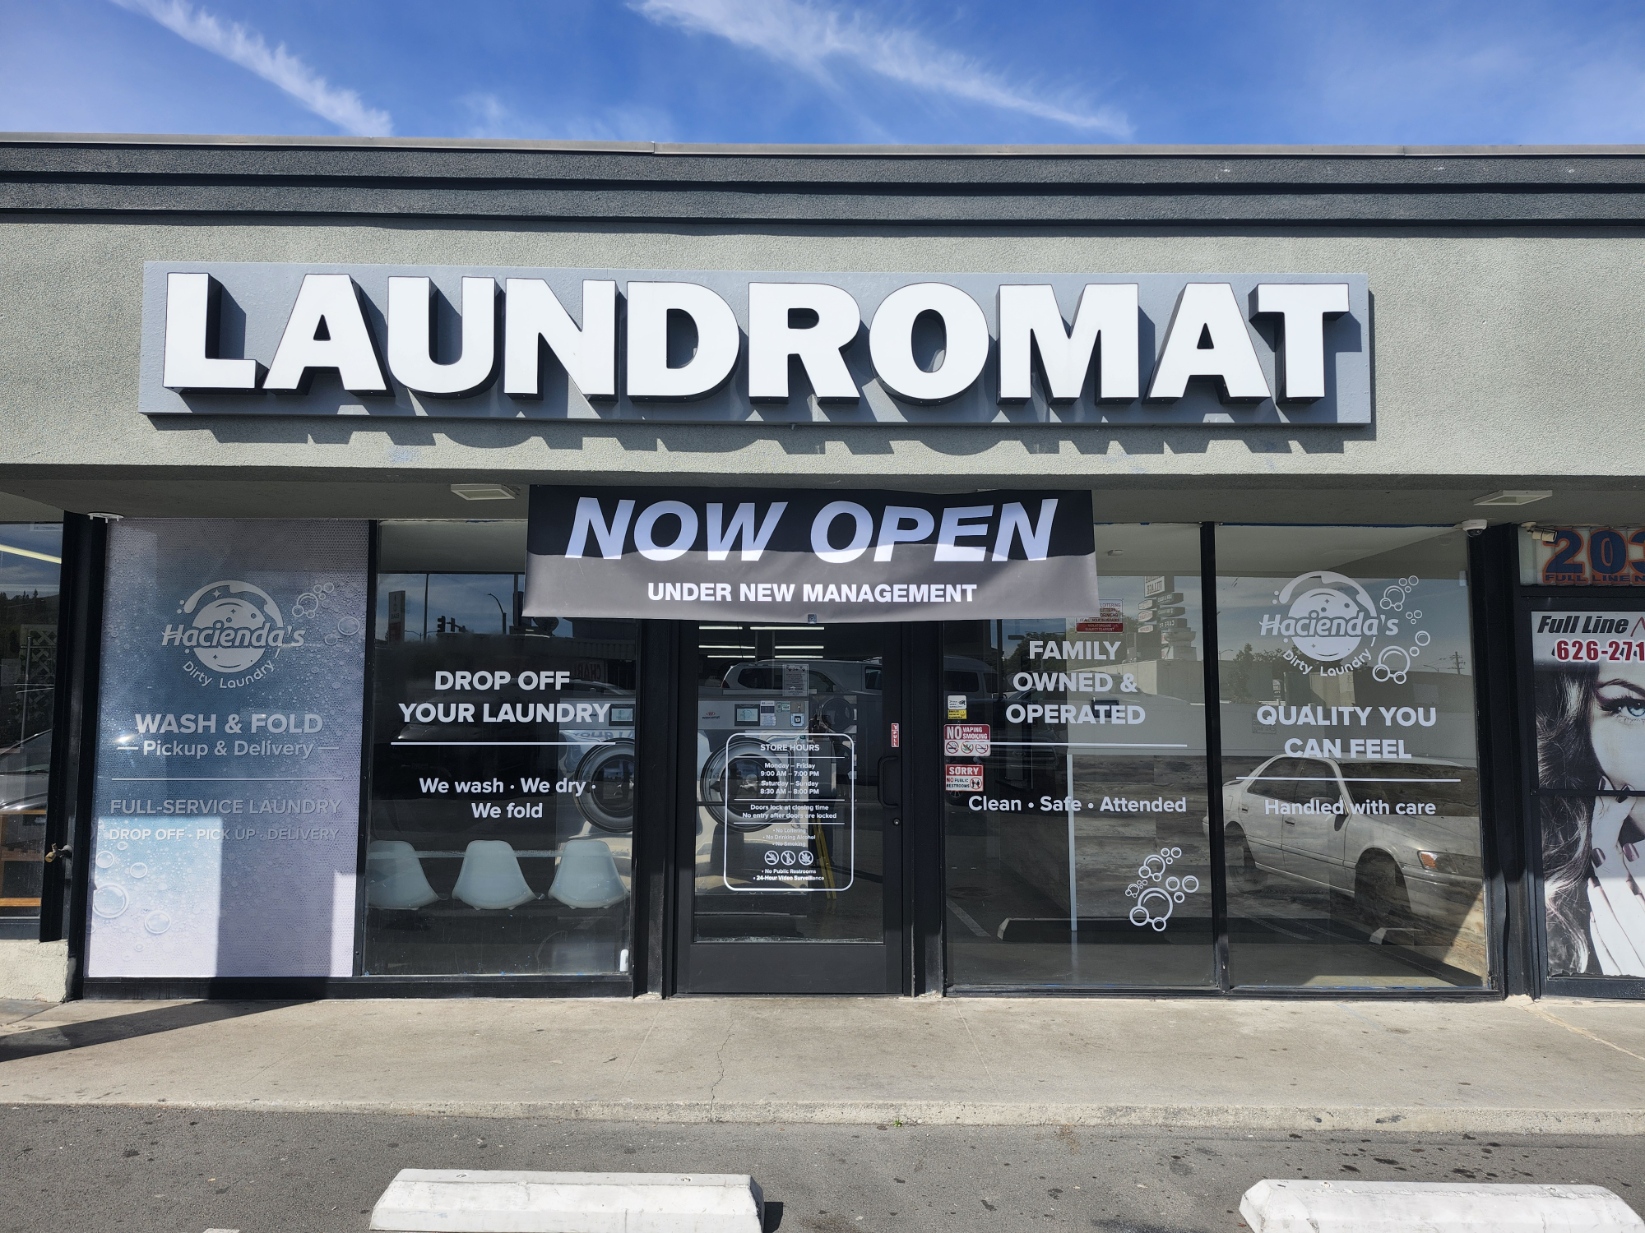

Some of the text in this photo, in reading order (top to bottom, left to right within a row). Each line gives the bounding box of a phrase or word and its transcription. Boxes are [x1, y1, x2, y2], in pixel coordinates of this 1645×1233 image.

[163, 272, 1350, 402] LAUNDROMAT
[564, 497, 1059, 564] NOW OPEN
[1545, 574, 1587, 582] FULL
[1592, 574, 1631, 582] LINE
[647, 583, 978, 603] UNDER NEW MANAGEMENT
[1259, 613, 1399, 637] Hacienda's
[1537, 615, 1580, 634] Full
[1581, 615, 1630, 634] Line
[162, 622, 305, 648] Hacienda's
[1029, 640, 1122, 660] FAMILY
[1282, 648, 1372, 678] Dirty Laundry
[183, 660, 275, 690] Dirty Laundry
[434, 670, 571, 691] DROP OFF
[1012, 672, 1138, 693] OWNED &
[398, 703, 611, 723] YOUR LAUNDRY
[1005, 704, 1146, 725] OPERATED
[1256, 705, 1437, 727] QUALITY YOU
[135, 713, 323, 734] WASH & FOLD
[946, 725, 962, 740] NO
[143, 740, 315, 761] Pickup & Delivery
[760, 744, 820, 752] STORE HOURS
[1284, 738, 1412, 759] CAN FEEL
[765, 762, 790, 770] Monday
[796, 762, 816, 770] Friday
[949, 766, 979, 775] SORRY
[419, 777, 587, 797] We wash We dry
[110, 799, 342, 815] FULL-SERVICE LAUNDRY
[471, 802, 543, 819] We fold
[791, 804, 814, 813] closing
[968, 796, 1187, 813] Clean Safe Attended
[1264, 799, 1437, 816] Handled with care
[752, 812, 769, 820] entry
[109, 828, 340, 841] DROP OFF PICK UP DELIVERY
